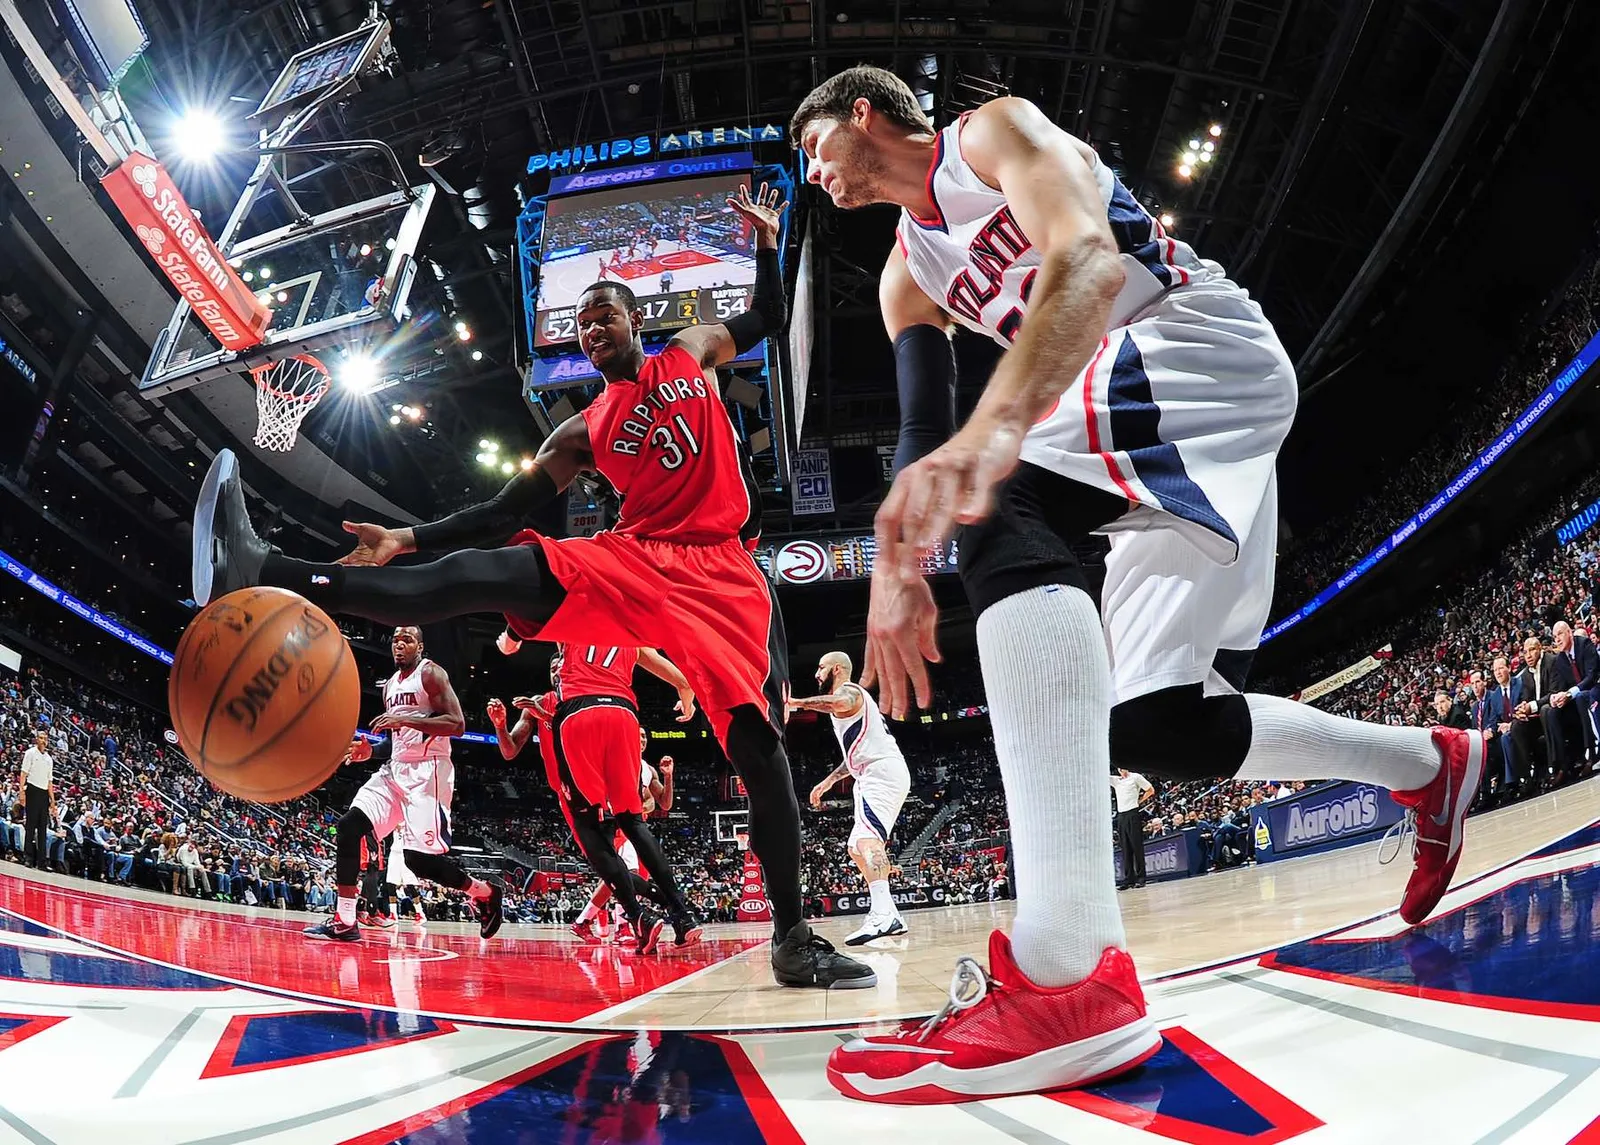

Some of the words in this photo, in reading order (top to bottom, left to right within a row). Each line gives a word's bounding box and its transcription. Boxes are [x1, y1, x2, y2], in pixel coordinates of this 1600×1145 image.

[526, 136, 651, 174] PHILIPS
[662, 124, 780, 151] ARENA
[564, 164, 660, 190] Aaron's
[668, 162, 717, 175] Own
[711, 287, 748, 299] RAPTORS
[683, 305, 693, 316] 2
[715, 297, 748, 319] 54
[546, 318, 576, 340] 52
[5, 349, 37, 384] ARENA
[612, 376, 707, 455] RAPTORS
[1480, 432, 1515, 468] Appliances
[1515, 392, 1554, 433] Aarons.com
[1555, 365, 1579, 392] Own
[651, 414, 698, 469] 31
[792, 458, 829, 474] PANIC
[799, 477, 827, 497] 20
[574, 515, 597, 526] 2010
[1556, 498, 1600, 545] PHILIP
[224, 606, 329, 734] SPALDING
[386, 692, 419, 711] TLANTA
[1285, 787, 1378, 846] Aaron's
[1145, 844, 1178, 875] aron's
[744, 902, 762, 910] KIA
[837, 896, 851, 910] G
[932, 888, 944, 901] G
